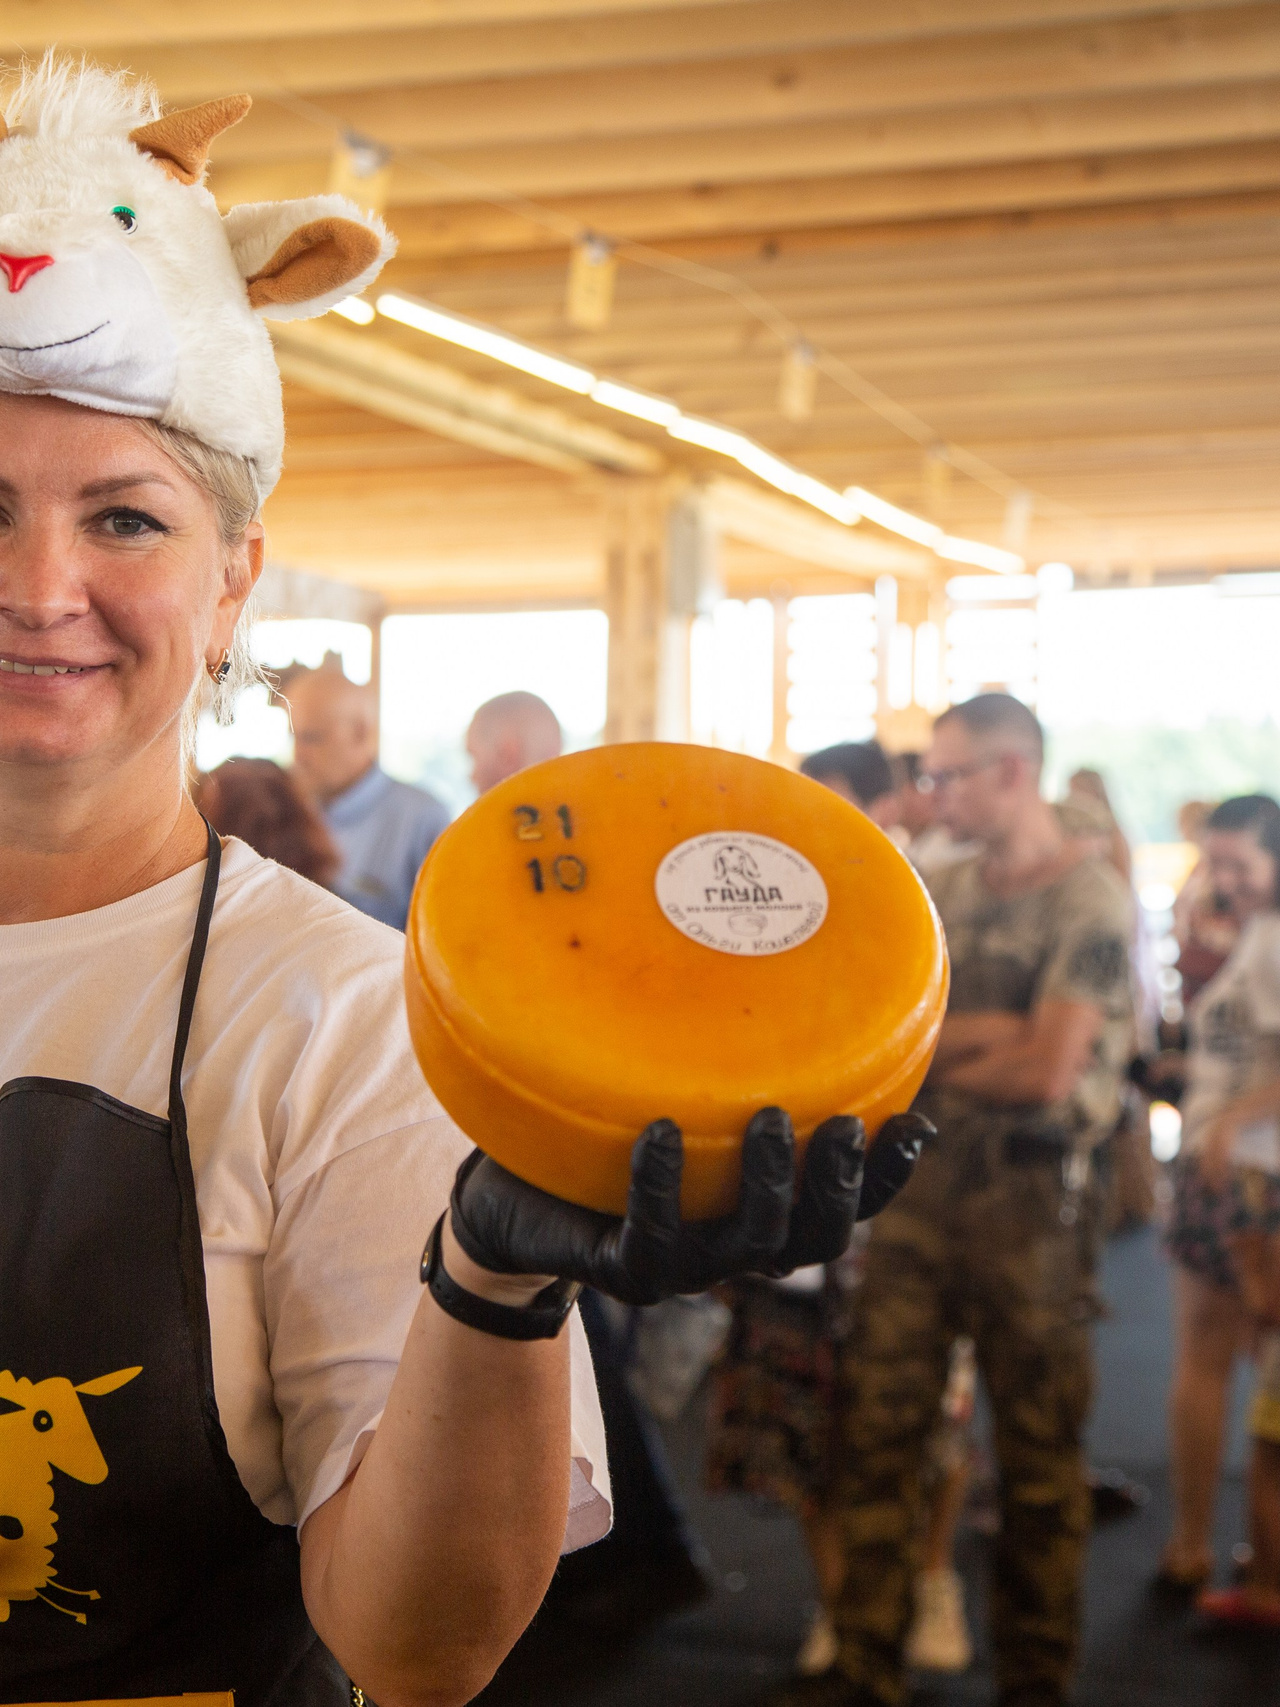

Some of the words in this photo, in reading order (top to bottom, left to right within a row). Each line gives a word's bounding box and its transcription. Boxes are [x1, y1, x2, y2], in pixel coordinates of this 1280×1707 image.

[514, 805, 574, 841] 21
[526, 856, 587, 893] 10
[704, 887, 783, 904] ГАУДА
